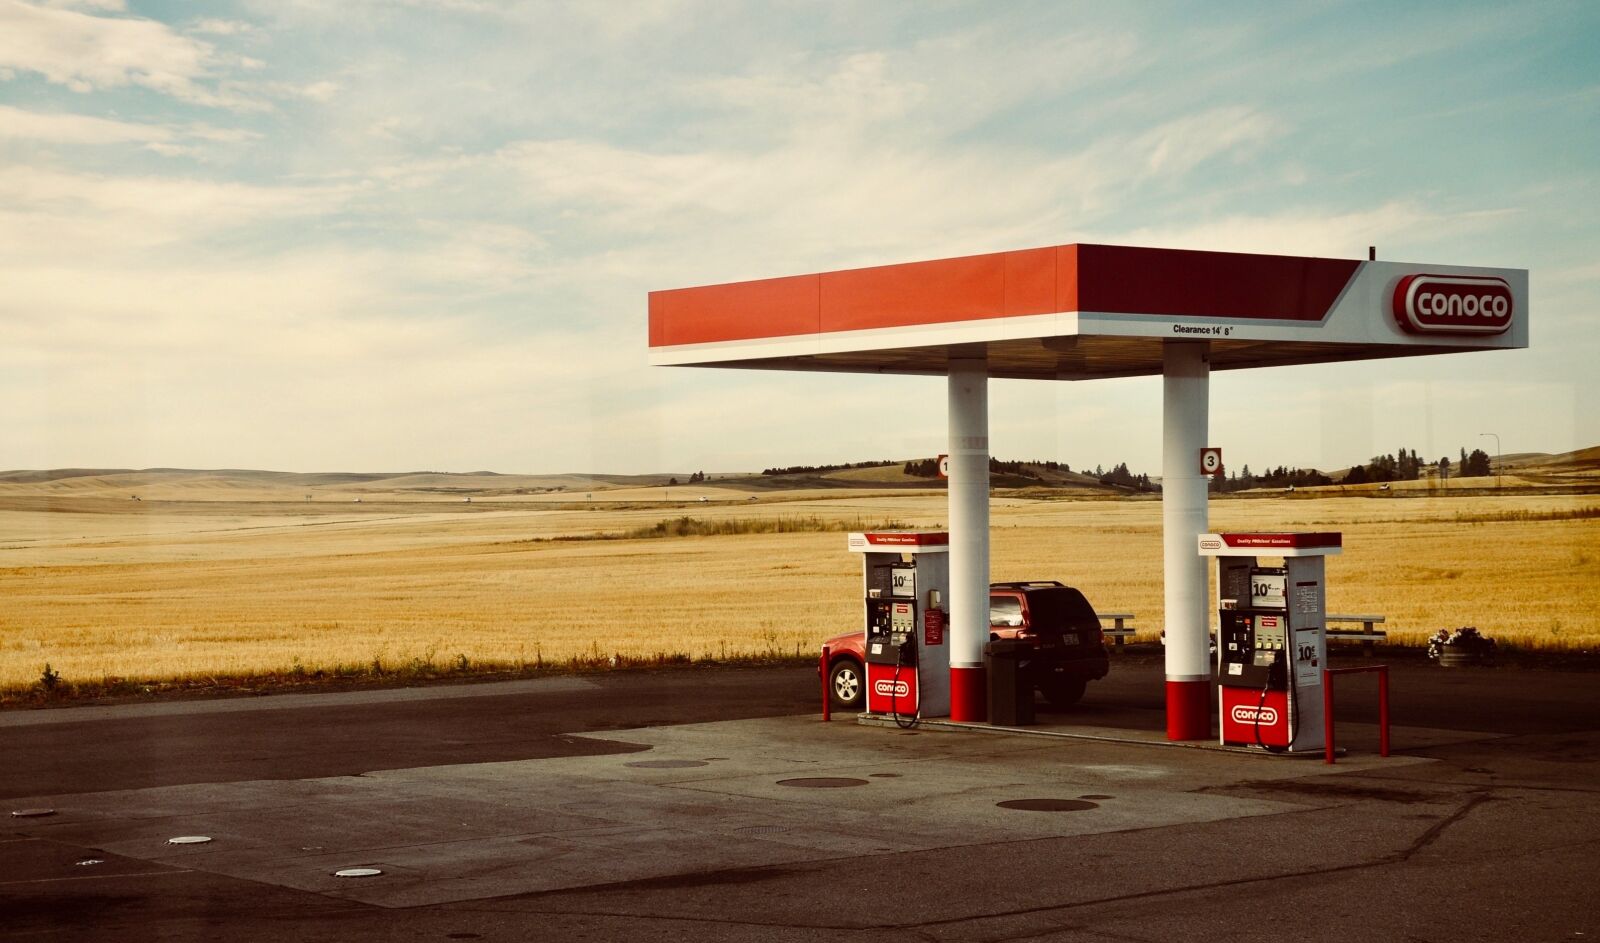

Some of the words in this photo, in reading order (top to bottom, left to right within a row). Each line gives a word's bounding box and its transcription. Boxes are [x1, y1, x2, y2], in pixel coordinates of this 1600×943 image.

[1173, 324, 1211, 334] Clearance
[943, 461, 948, 472] 1
[1207, 455, 1215, 467] 3
